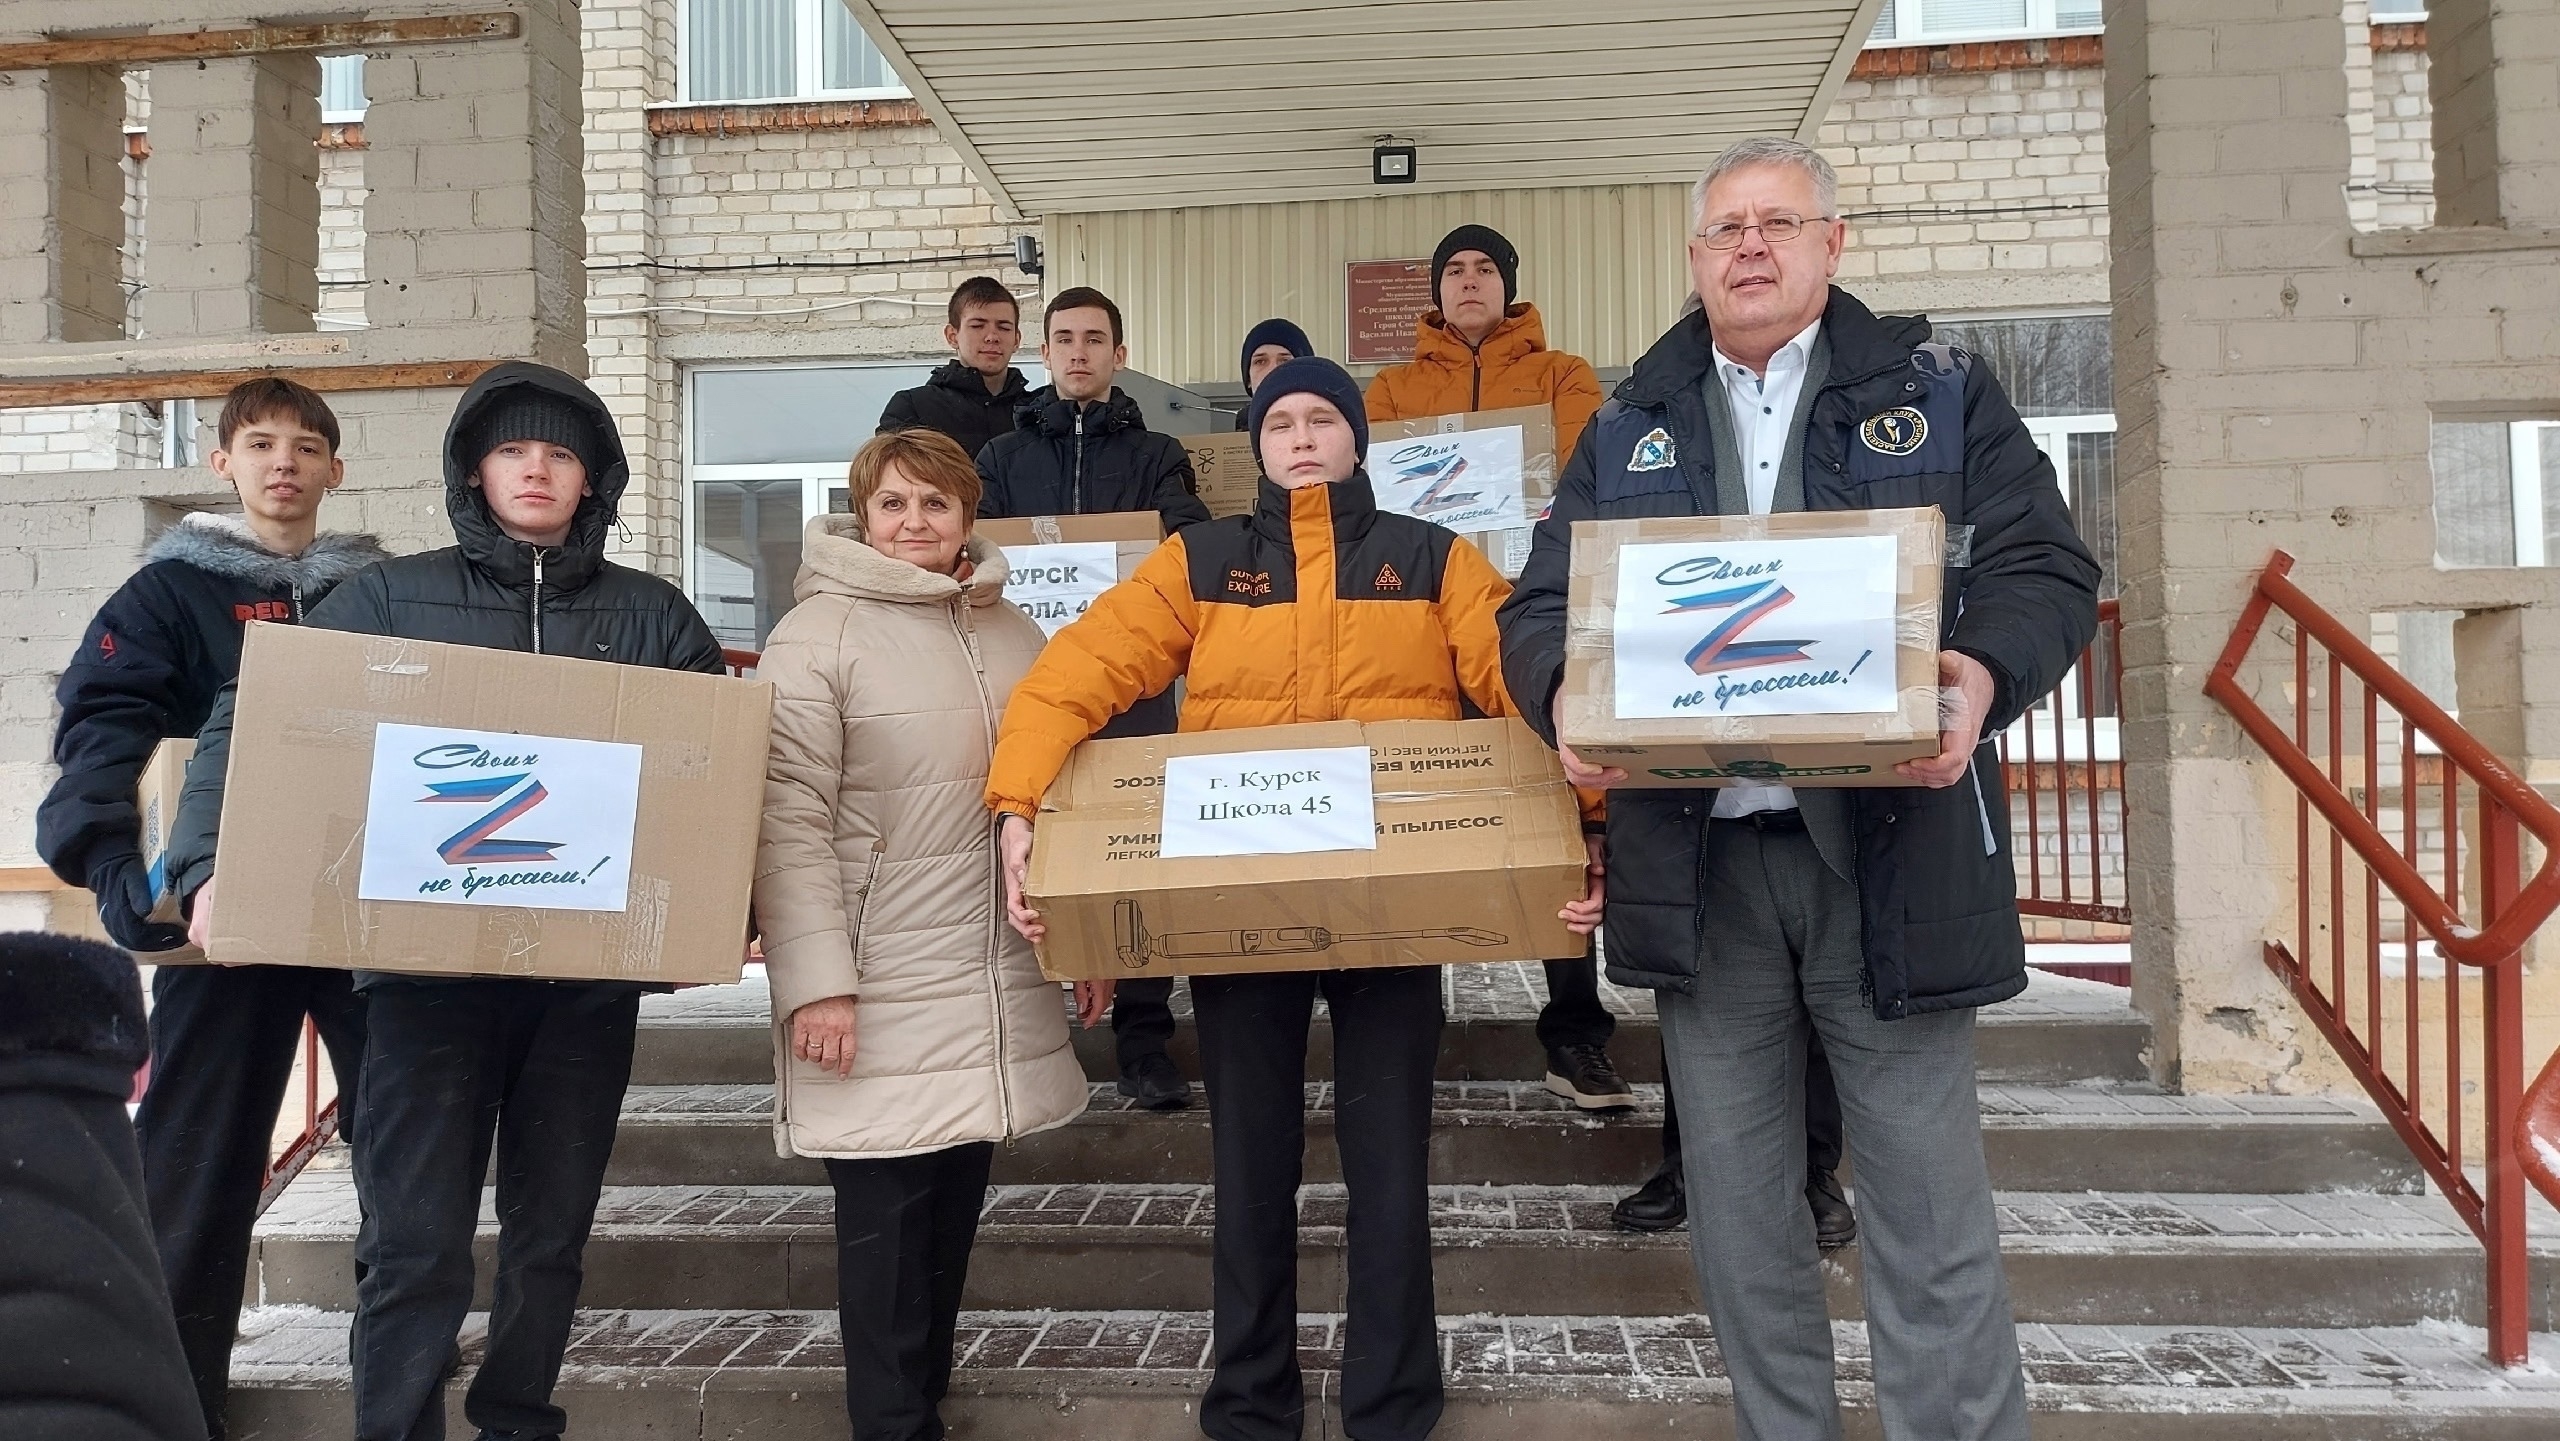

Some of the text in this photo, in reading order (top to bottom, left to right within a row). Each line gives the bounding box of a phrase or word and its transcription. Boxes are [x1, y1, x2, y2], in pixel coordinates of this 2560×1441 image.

[1399, 304, 1439, 313] общеобра
[1373, 320, 1418, 330] Героя Сове
[1359, 329, 1417, 339] Василия Иван
[1894, 410, 1914, 418] КЛУБ
[1387, 442, 1460, 465] Своих
[1230, 569, 1270, 584] OUTDOOR
[1655, 556, 1784, 586] Своих
[1228, 580, 1272, 597] EXPLORE
[233, 601, 290, 622] RED
[1018, 601, 1069, 619] ОЛА
[1672, 649, 1873, 711] не бросаем!
[412, 743, 539, 769] Своих
[1391, 746, 1423, 756] ВЕС
[1428, 744, 1491, 757] ЛЕГКИЙ
[1410, 757, 1495, 774] УМНЫЙ
[1112, 775, 1166, 789] ЕСОС
[1208, 770, 1321, 792] г. Курск
[1197, 795, 1333, 821] Школа 45
[1391, 815, 1504, 834] ПЫЛЕСОС
[1105, 850, 1161, 862] ЛЕГКИ
[418, 855, 612, 900] не бросаем!
